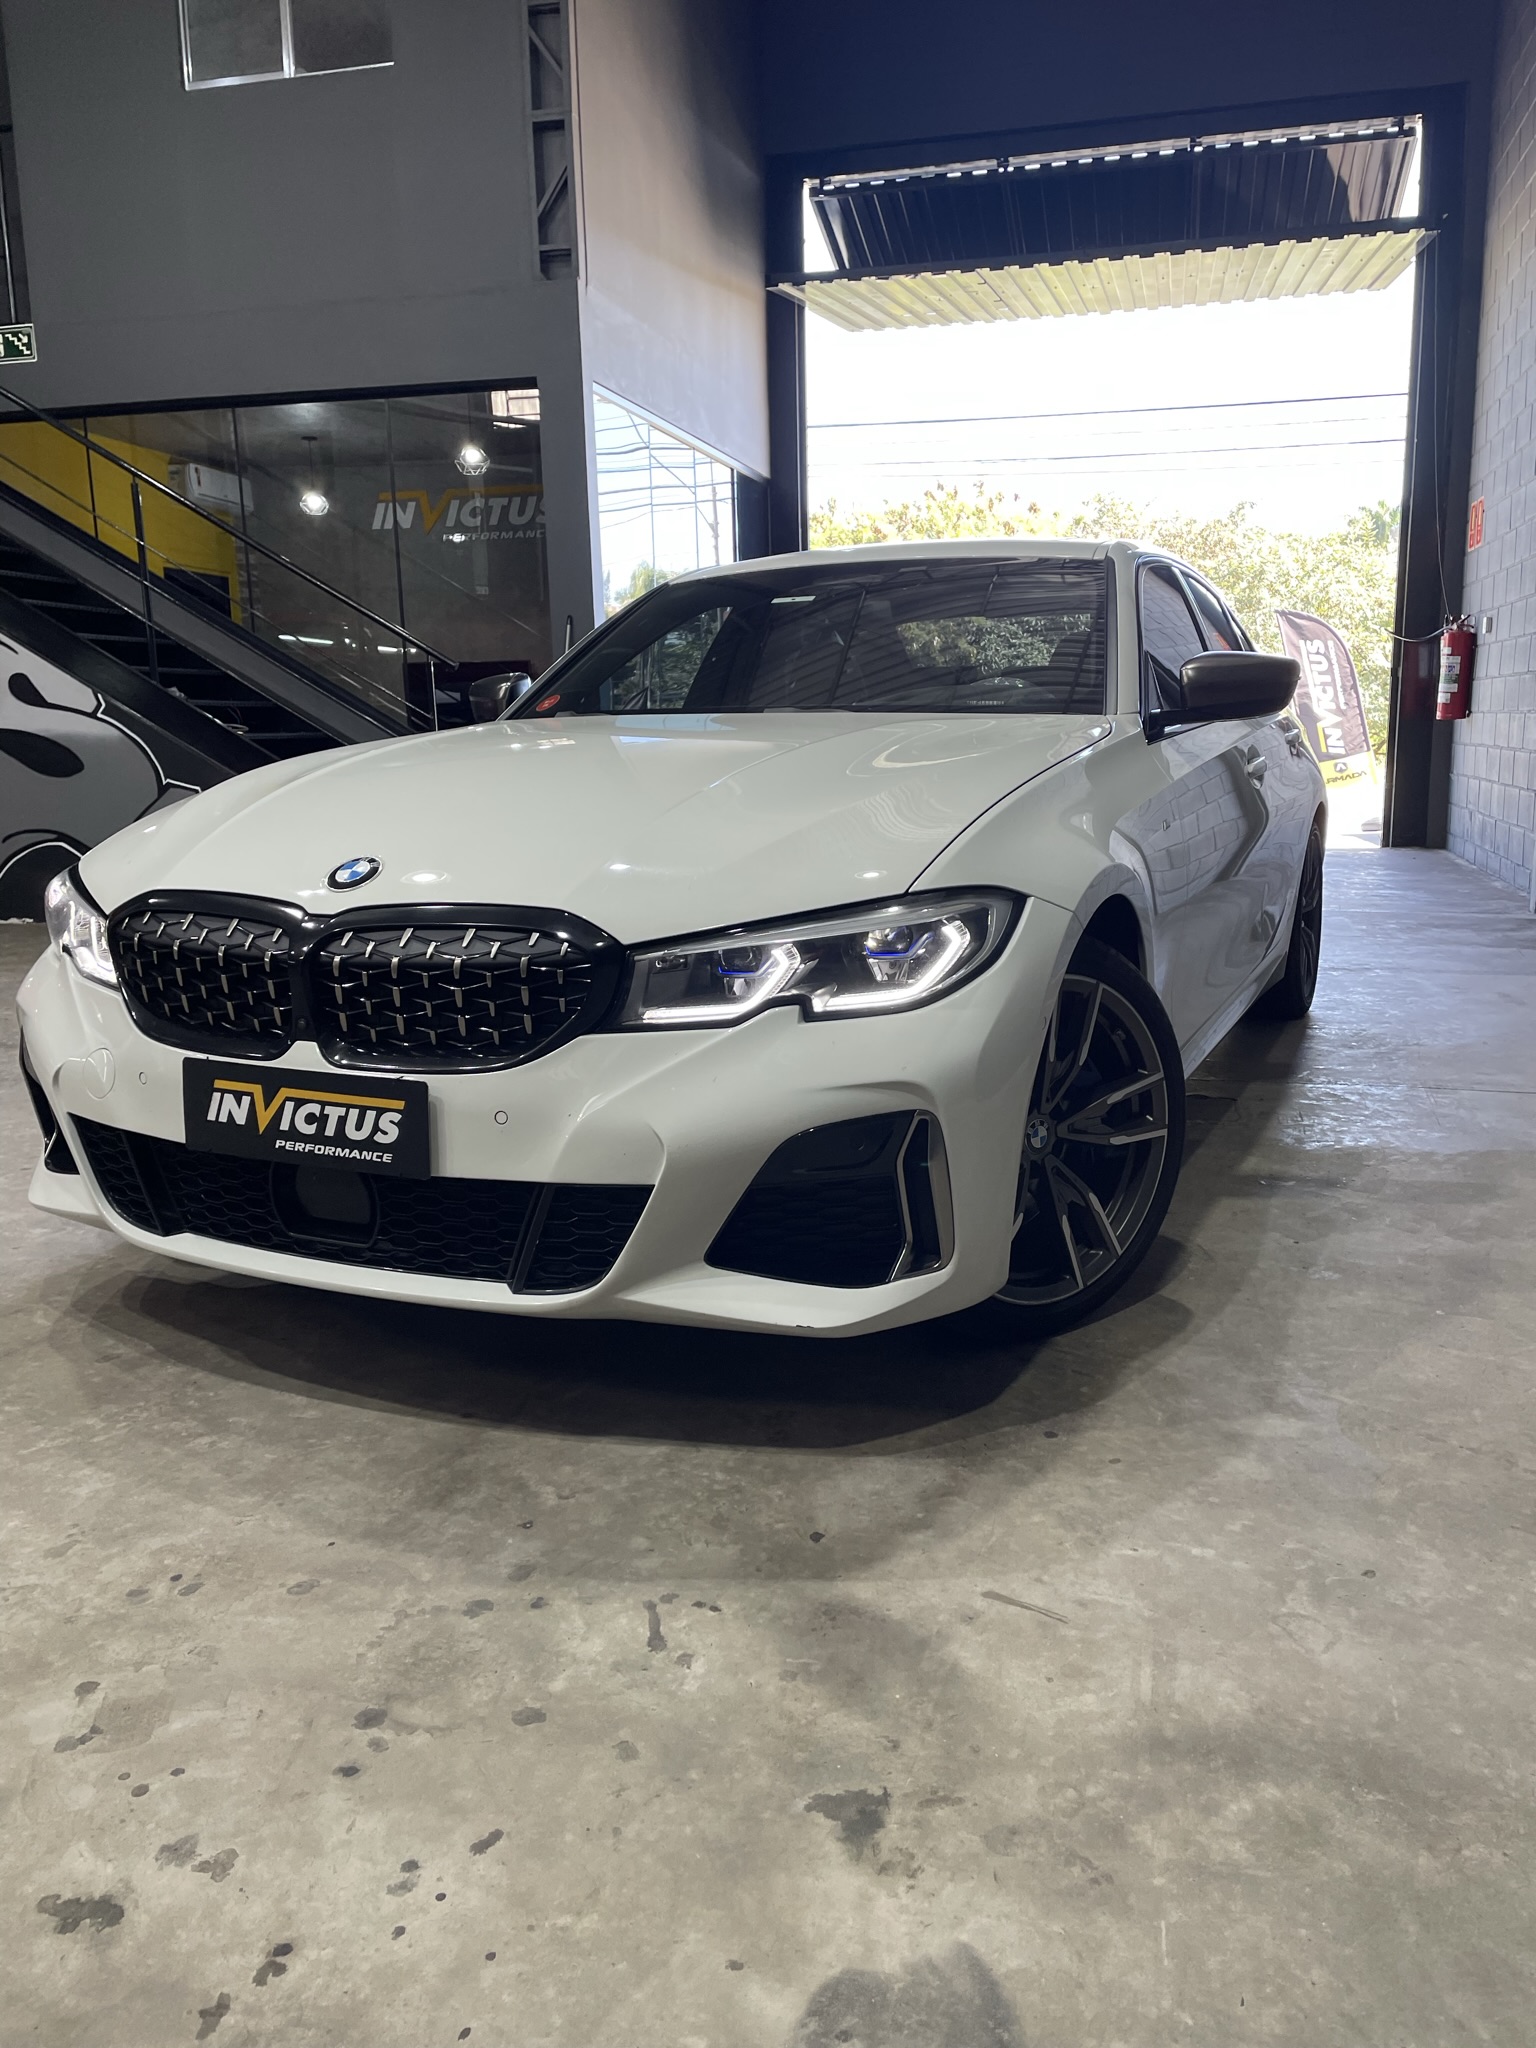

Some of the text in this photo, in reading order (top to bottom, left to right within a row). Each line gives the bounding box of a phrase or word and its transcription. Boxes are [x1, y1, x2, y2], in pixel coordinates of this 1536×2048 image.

[442, 529, 545, 542] PERFORMANC
[1299, 639, 1346, 755] INVICTUS
[1325, 770, 1368, 785] RMADA
[207, 1079, 406, 1144] INVICTUS
[275, 1139, 393, 1163] PERFORMANCE
